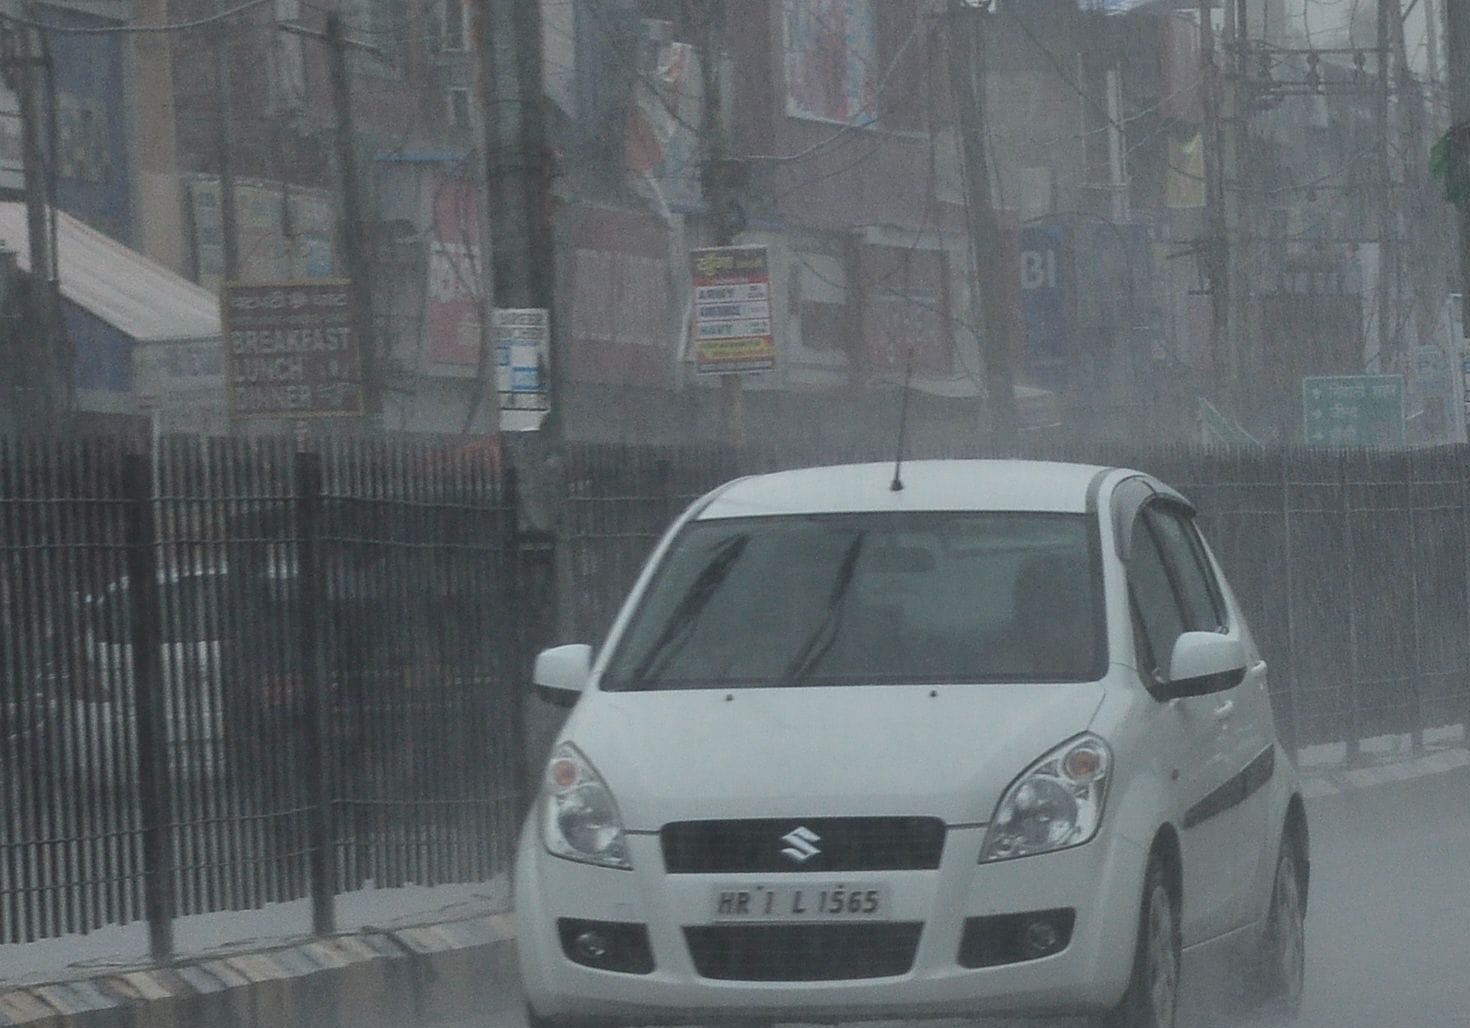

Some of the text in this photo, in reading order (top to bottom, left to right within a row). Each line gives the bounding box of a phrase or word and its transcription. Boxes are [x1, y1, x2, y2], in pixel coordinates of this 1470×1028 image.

[231, 328, 351, 353] BREAKFAST
[234, 357, 304, 382] LUNCH
[235, 385, 311, 410] DINNER
[718, 891, 749, 914] HR
[819, 890, 879, 914] 1565
